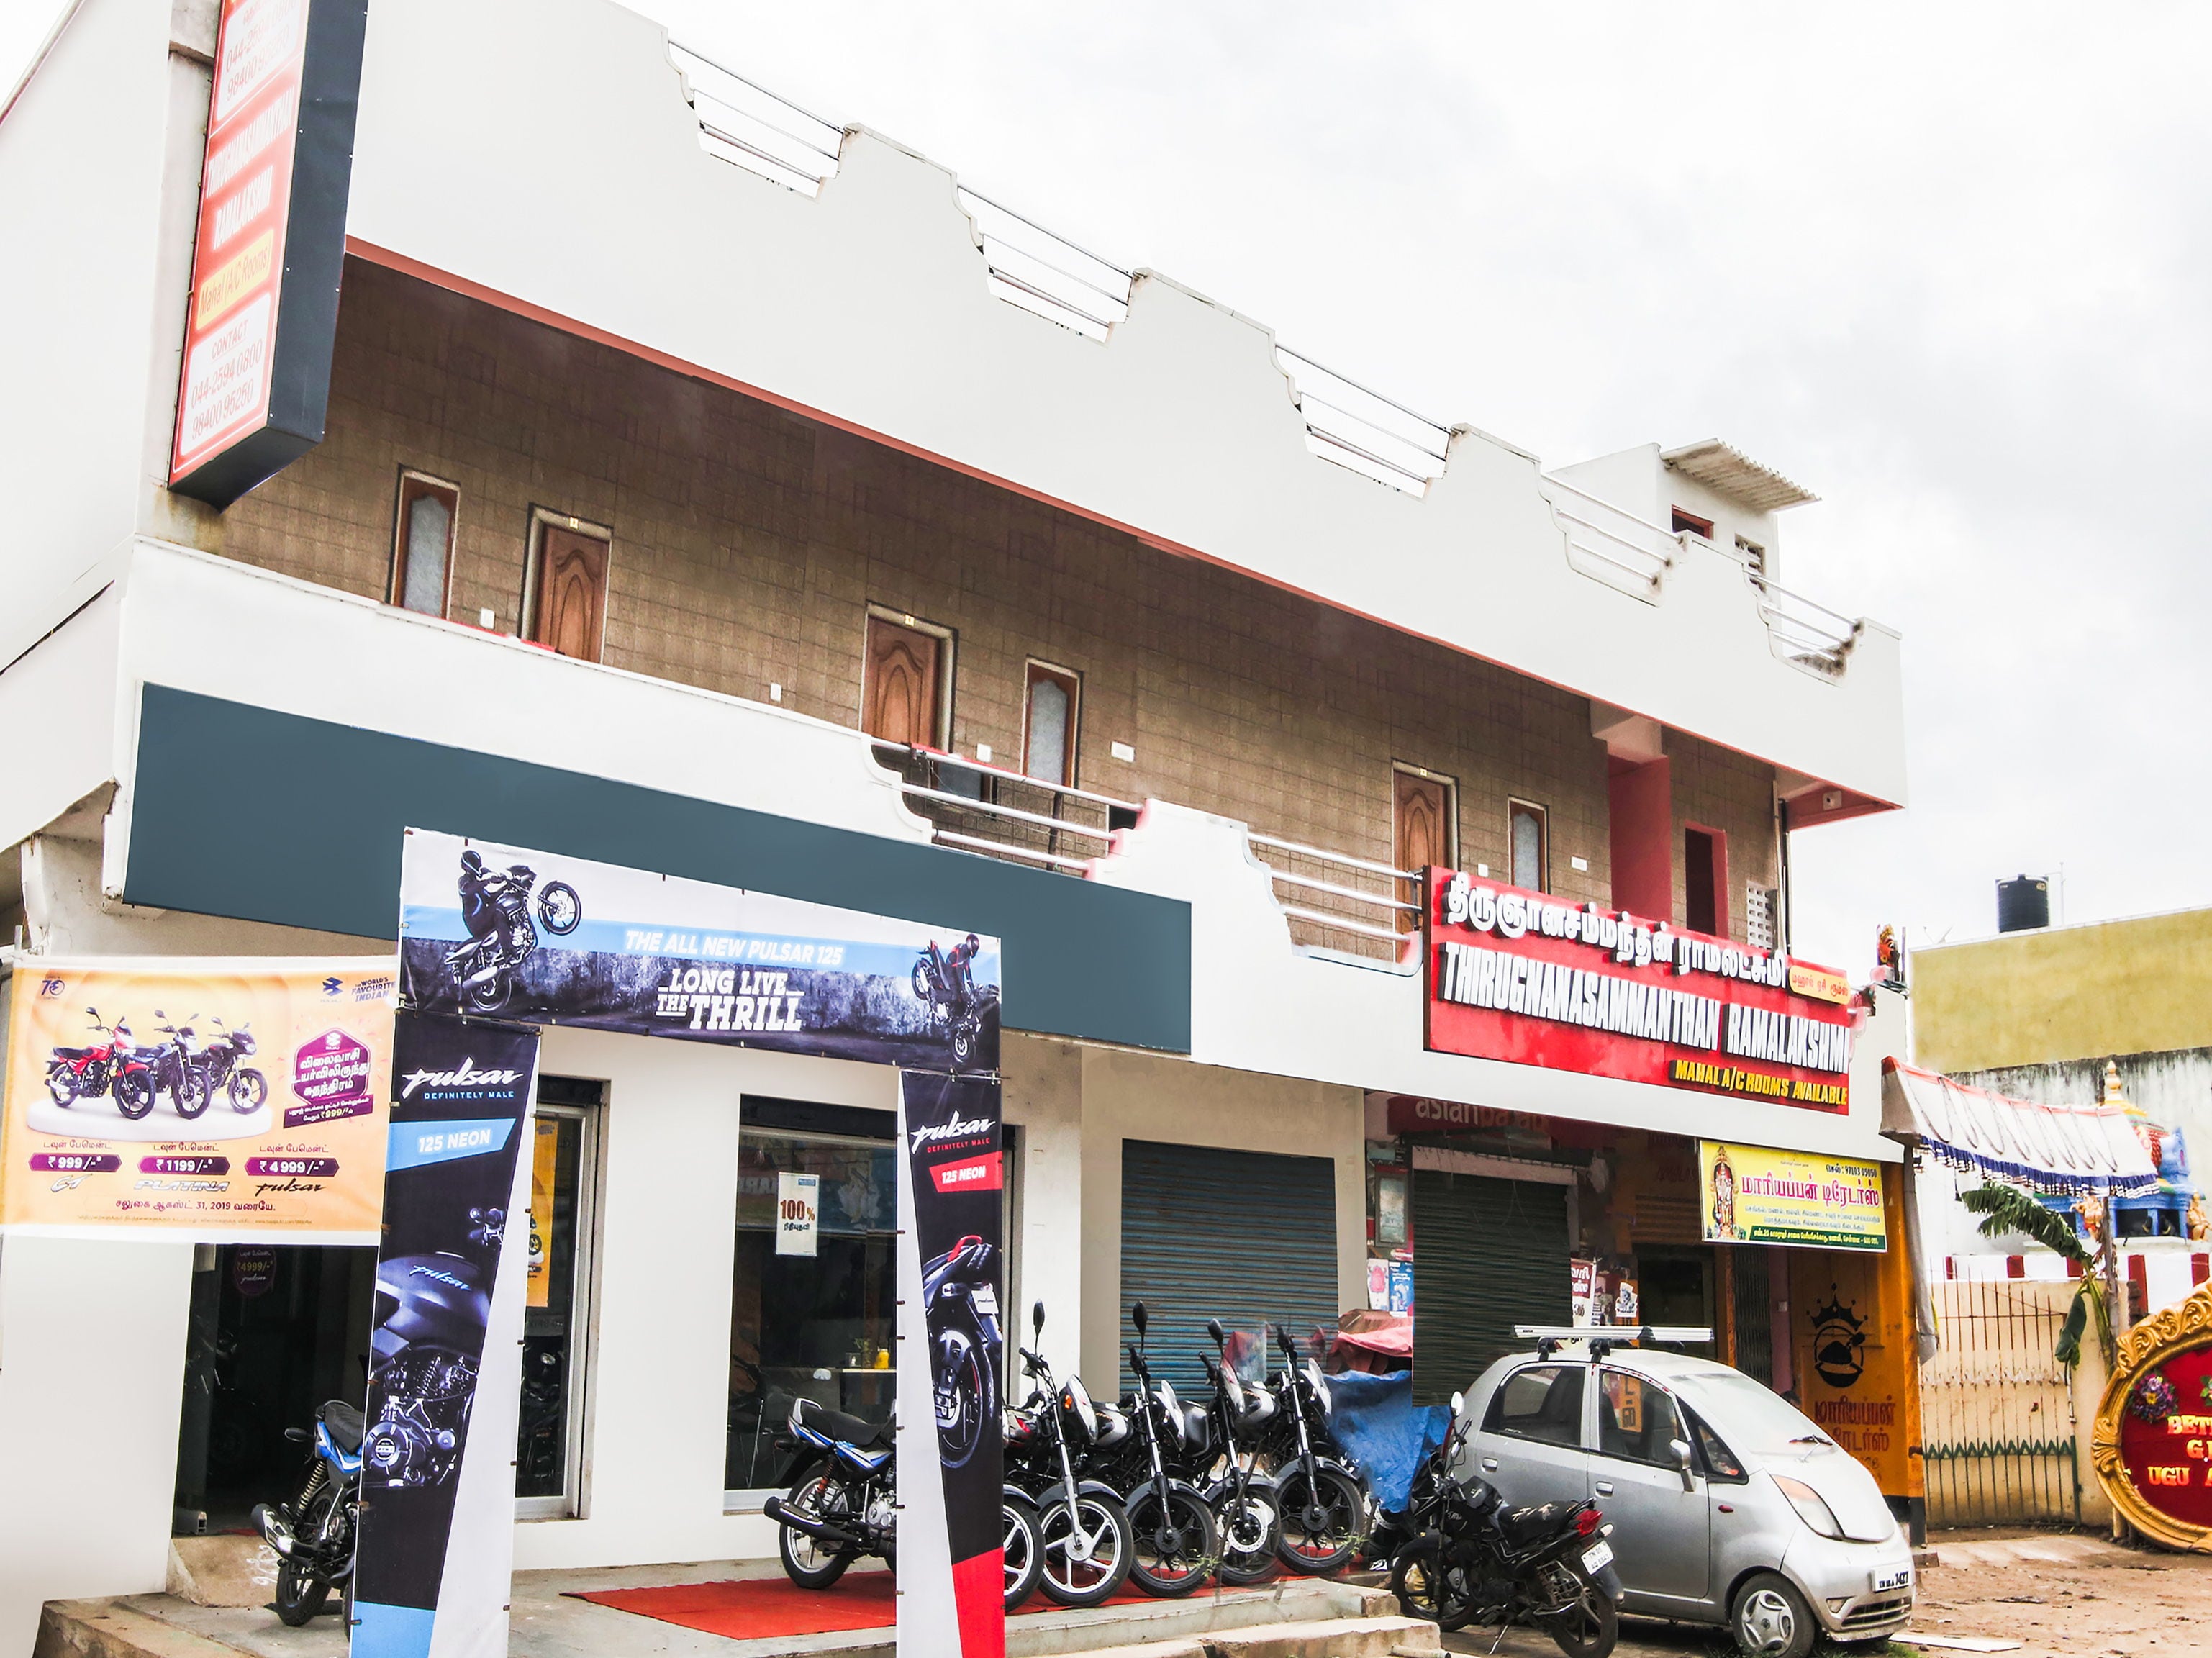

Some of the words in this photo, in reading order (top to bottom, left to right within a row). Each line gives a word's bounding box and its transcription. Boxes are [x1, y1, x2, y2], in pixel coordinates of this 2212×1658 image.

[199, 279, 223, 317] Mahal
[212, 320, 249, 359] CONTACT
[191, 358, 235, 409] 044-2594
[235, 339, 263, 381] 0800
[191, 399, 222, 440] 98400
[222, 378, 253, 423] 95250
[1446, 871, 1674, 967] திருஞானசம்மந்தன்
[1678, 938, 1787, 989] ராமலட்சுமி
[625, 930, 663, 951] THE
[663, 934, 698, 954] ALL
[702, 936, 747, 958] NEW
[748, 941, 815, 963] PULSAR
[817, 946, 844, 965] 125
[351, 982, 396, 995] FAVOURITE
[361, 977, 389, 987] WORLD'S
[670, 968, 735, 995] LONG
[739, 971, 788, 996] LIVE
[355, 990, 389, 1002] INDIAN
[656, 994, 688, 1012] THE
[1443, 941, 1721, 1051] THIRUGNANASAMMANTHAN
[1727, 1002, 1850, 1074] RAMALAKSHMI
[689, 995, 802, 1032] THRILL
[300, 1047, 361, 1069] விலைவாசி
[290, 1062, 370, 1084] உயர்விலிருந்து
[402, 1056, 524, 1099] pulsar
[1674, 1059, 1720, 1086] MAHAL
[1721, 1066, 1745, 1091] A/C
[1746, 1075, 1790, 1097] ROOMS
[1792, 1081, 1847, 1105] AVAILABLE
[304, 1077, 354, 1098] சுதந்திரம்
[418, 1135, 444, 1153] 125
[447, 1129, 491, 1149] NEON
[910, 1110, 996, 1154] pulsar
[927, 1141, 969, 1153] DEFINITELY
[971, 1137, 990, 1146] MALE
[941, 1170, 958, 1184] 125
[958, 1164, 986, 1181] NEON
[1844, 1166, 1861, 1176] 97103
[133, 1179, 230, 1192] PLATINA
[255, 1177, 326, 1197] pulsar
[1741, 1171, 1818, 1200] மாரியப்பன்
[1821, 1178, 1880, 1208] டிரேடர்ஸ்
[116, 1200, 150, 1210] சலுகை
[153, 1200, 193, 1212] ஆகஸ்ட்
[196, 1201, 207, 1211] 31,
[210, 1201, 231, 1210] 2019
[1813, 1394, 1895, 1427] மாரியப்பன்
[2167, 1415, 2212, 1436] BET
[2147, 1466, 2190, 1486] UGU
